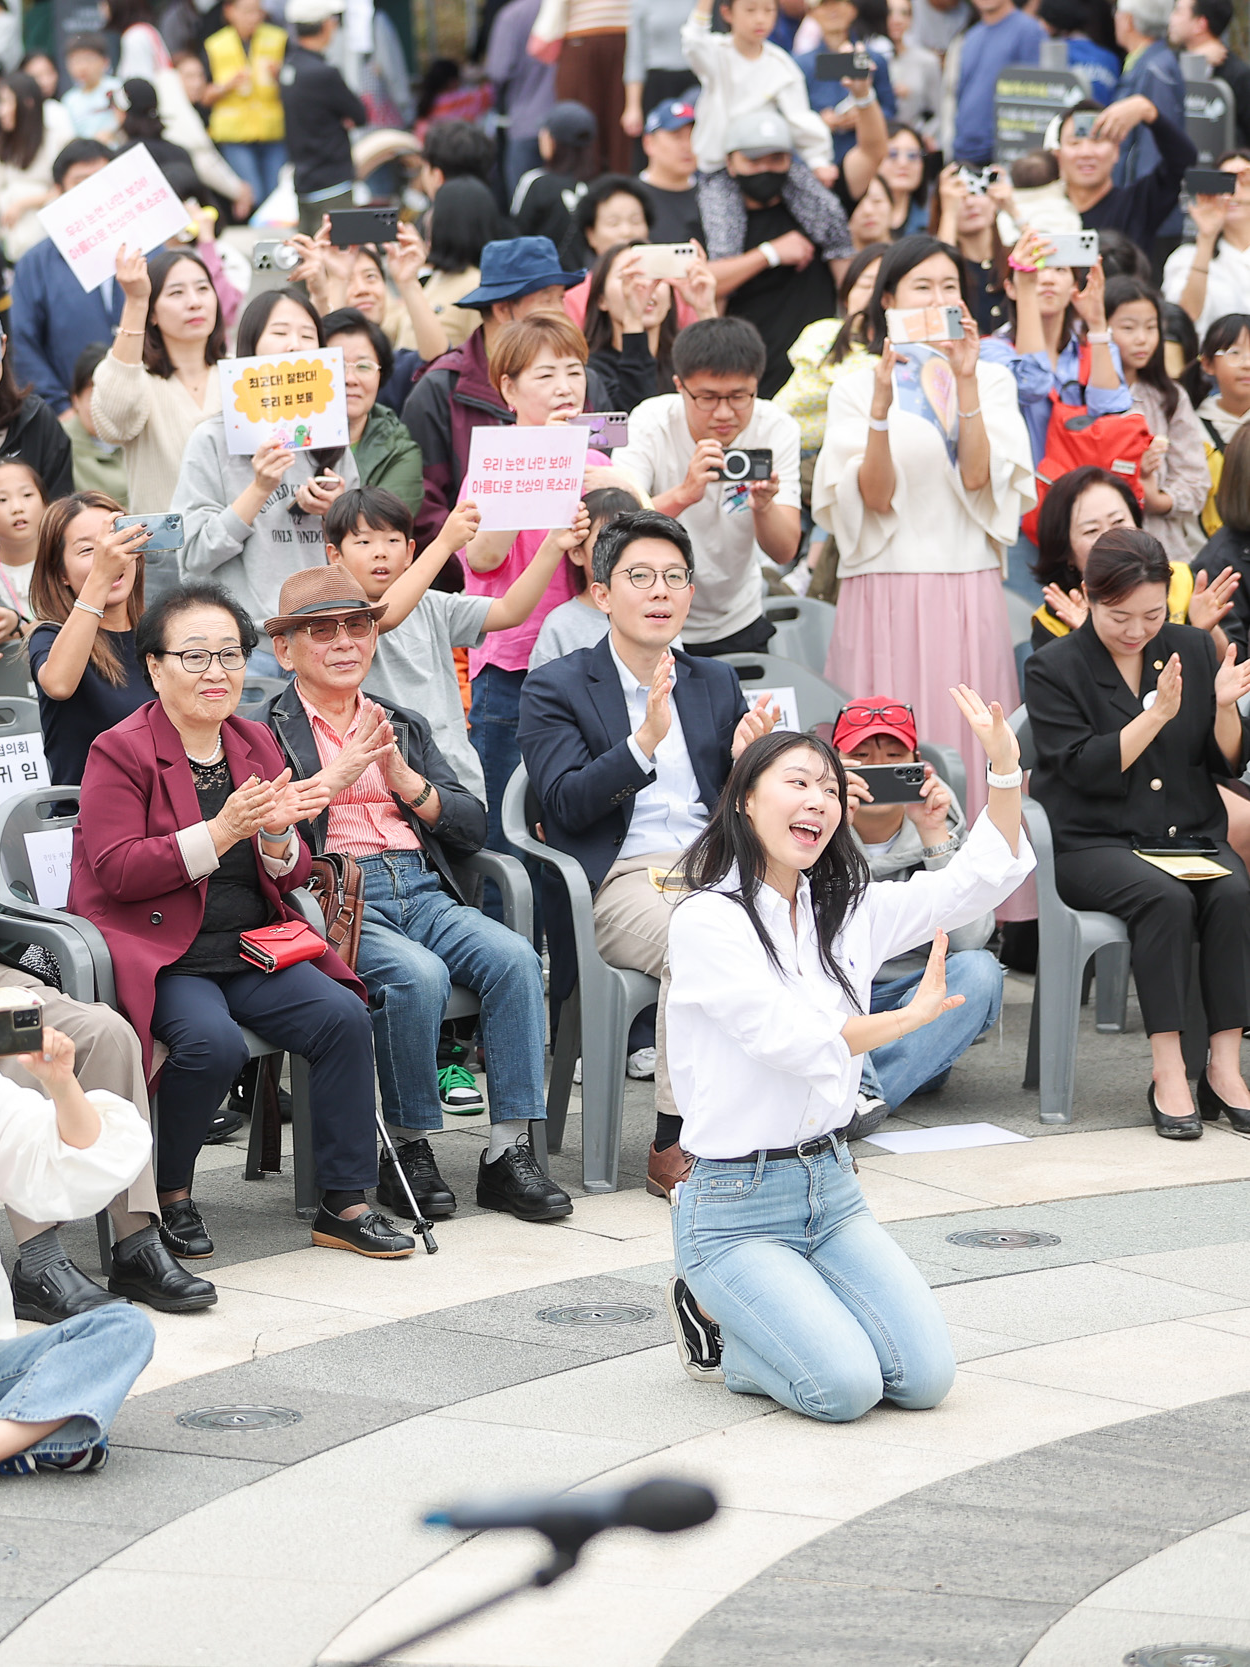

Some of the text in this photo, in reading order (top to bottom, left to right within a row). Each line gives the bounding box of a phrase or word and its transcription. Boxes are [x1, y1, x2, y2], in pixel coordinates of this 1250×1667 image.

[249, 369, 318, 389] 최고다! 잘한다!
[260, 391, 314, 409] 우리 집 보물
[482, 455, 573, 472] 우리 눈엔 너만 보여!
[471, 477, 578, 495] 아름다운 천상의 목소리!
[271, 529, 293, 543] ONLY
